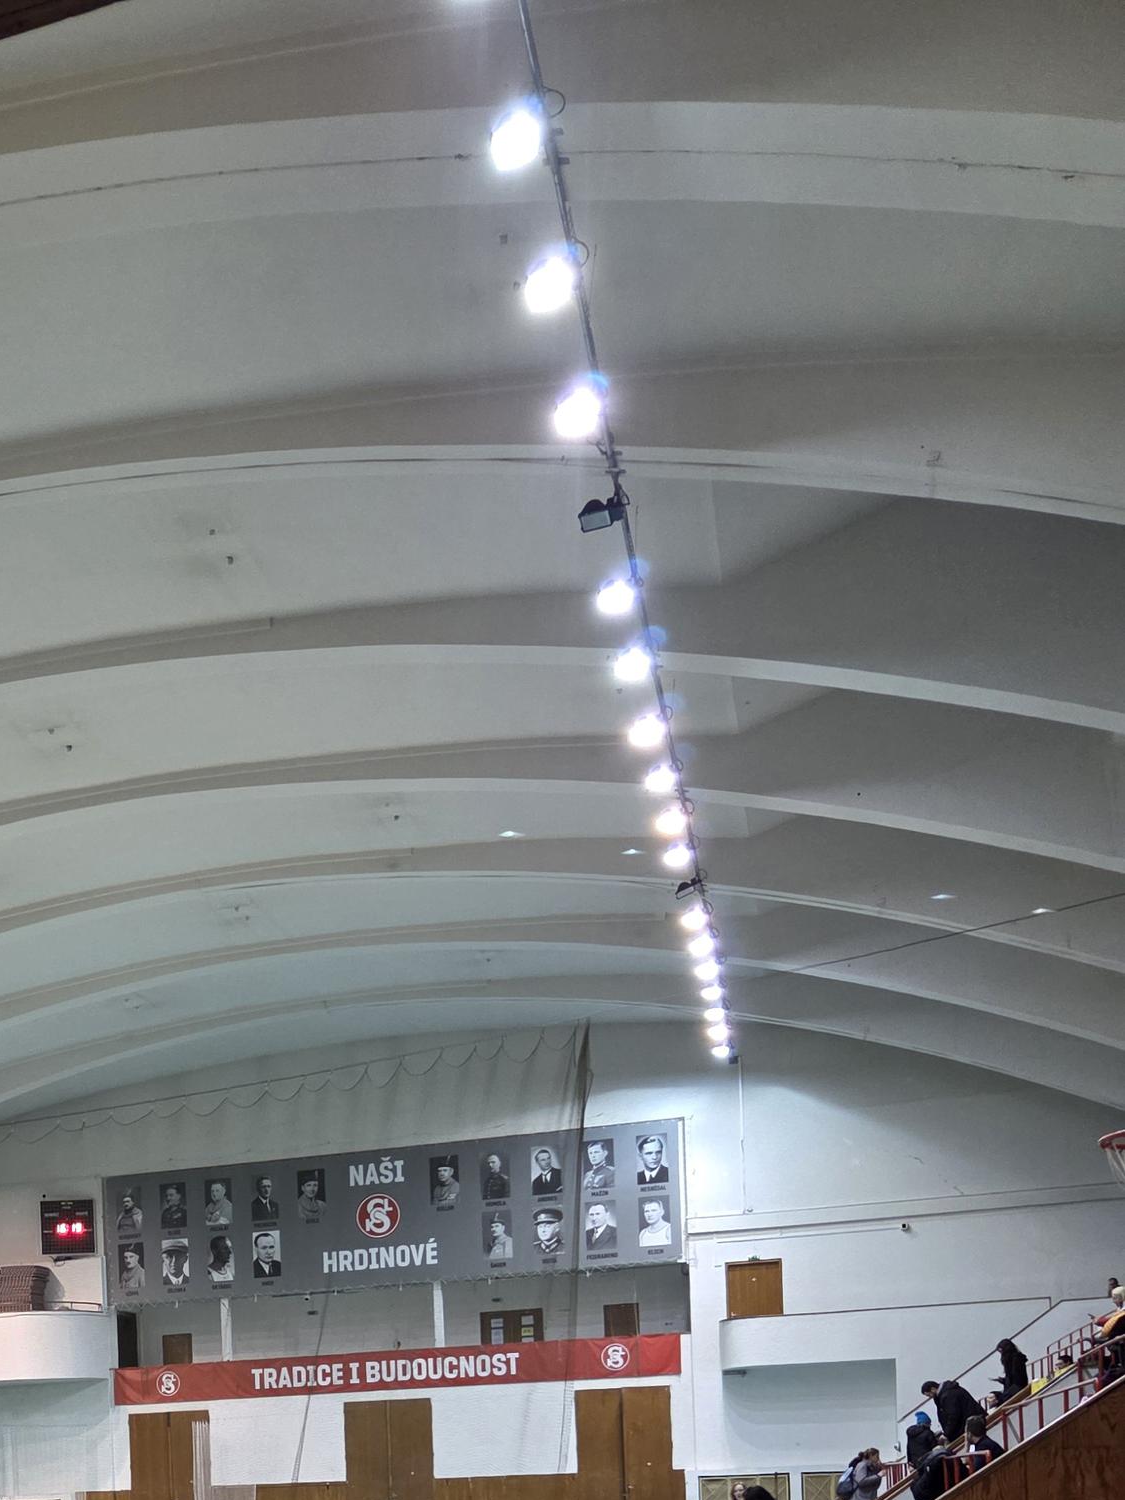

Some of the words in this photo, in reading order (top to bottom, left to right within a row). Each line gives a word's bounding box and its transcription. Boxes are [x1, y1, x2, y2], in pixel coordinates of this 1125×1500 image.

[349, 1156, 405, 1187] NAŠI
[322, 1237, 439, 1274] HRDINOVÉ
[251, 1361, 343, 1390] TRADICE
[349, 1363, 360, 1384] I
[365, 1353, 519, 1384] BUDOUCNOST
